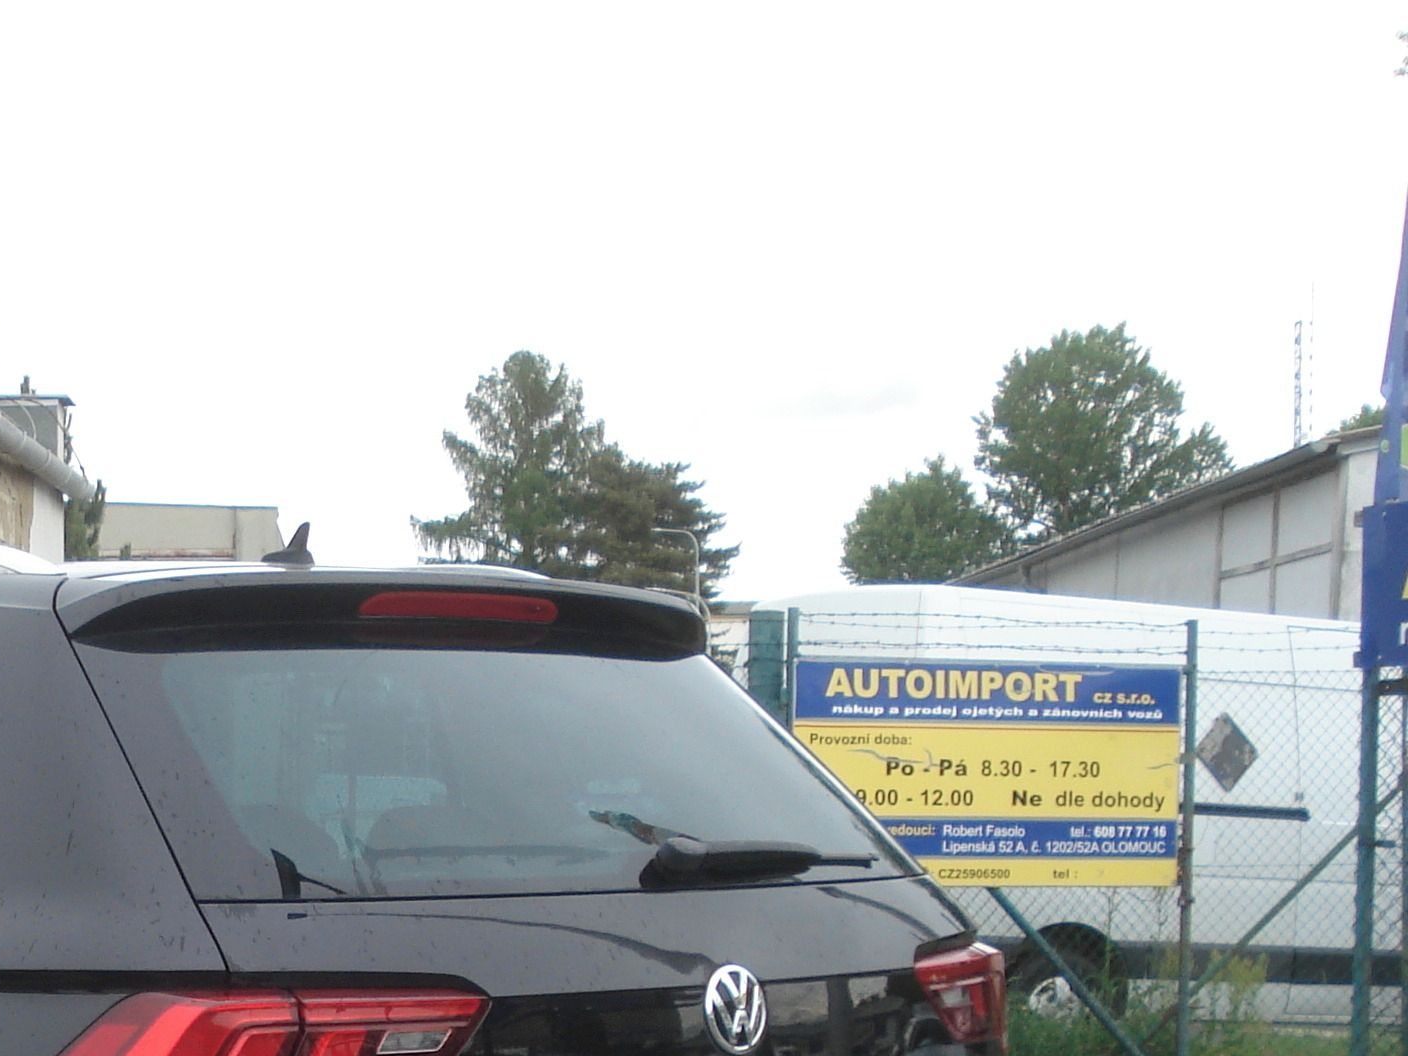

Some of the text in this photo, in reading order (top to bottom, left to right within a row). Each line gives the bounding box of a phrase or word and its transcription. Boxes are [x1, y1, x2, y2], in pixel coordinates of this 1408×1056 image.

[825, 667, 1155, 705] AUTOIMPORT cz s.r.o.
[832, 704, 884, 716] nákup
[889, 707, 899, 715] a
[904, 705, 957, 718] prodej
[962, 706, 1023, 718] ojetých
[1028, 708, 1038, 717] a
[1043, 707, 1122, 719] zánovních
[809, 733, 912, 745] Provozní doba:
[886, 757, 914, 776] Po
[939, 758, 967, 776] Pá
[981, 760, 1022, 777] 8.30
[1049, 761, 1100, 778] 17.30
[920, 789, 974, 806] 12.00
[1012, 790, 1042, 806] Ne
[1055, 791, 1085, 807] dle
[1092, 791, 1165, 812] dohody
[943, 825, 983, 837] Robert
[986, 825, 1026, 837] Fasolo
[1093, 826, 1115, 838] 608
[1118, 826, 1131, 838] 77
[1135, 826, 1150, 838] 77
[1153, 826, 1167, 838] 16
[999, 841, 1013, 853] 52
[1101, 841, 1166, 854] OLOMOUC
